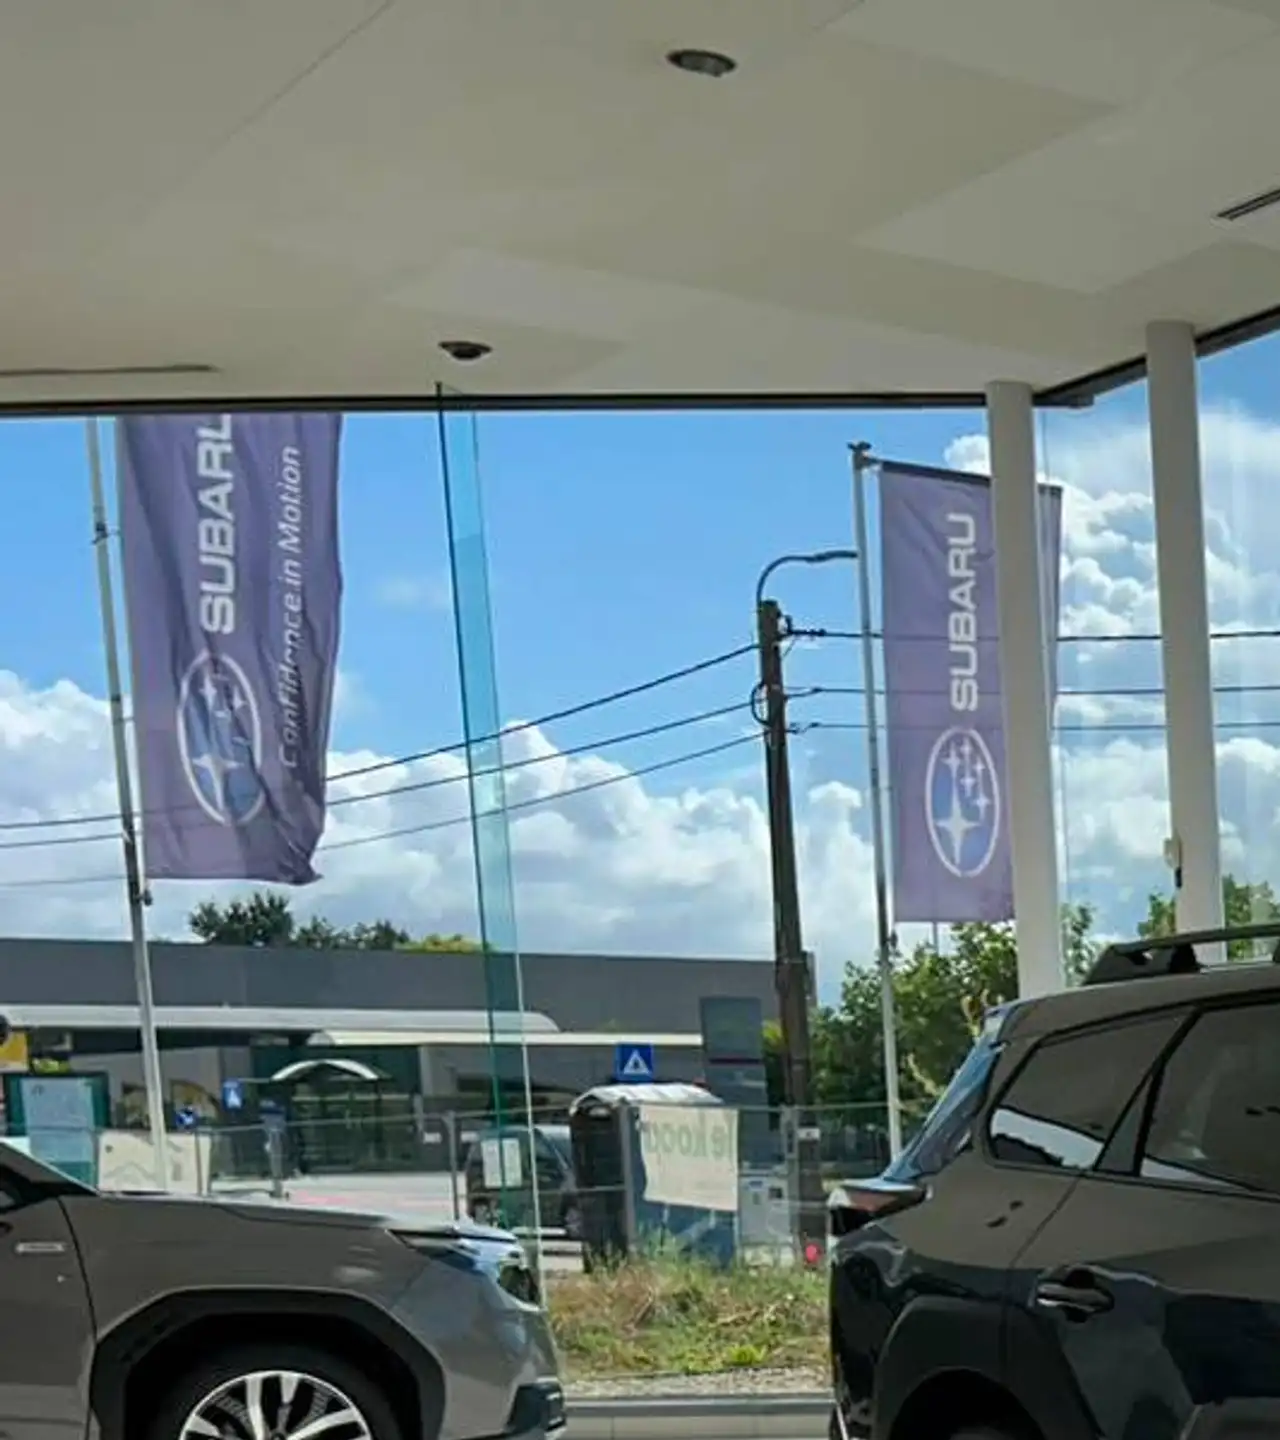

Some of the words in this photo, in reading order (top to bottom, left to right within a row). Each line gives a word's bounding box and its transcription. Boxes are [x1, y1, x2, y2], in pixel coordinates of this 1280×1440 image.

[277, 445, 301, 549] Motion
[278, 557, 301, 591] in
[947, 512, 978, 712] SUBARU
[278, 593, 302, 768] Confidence
